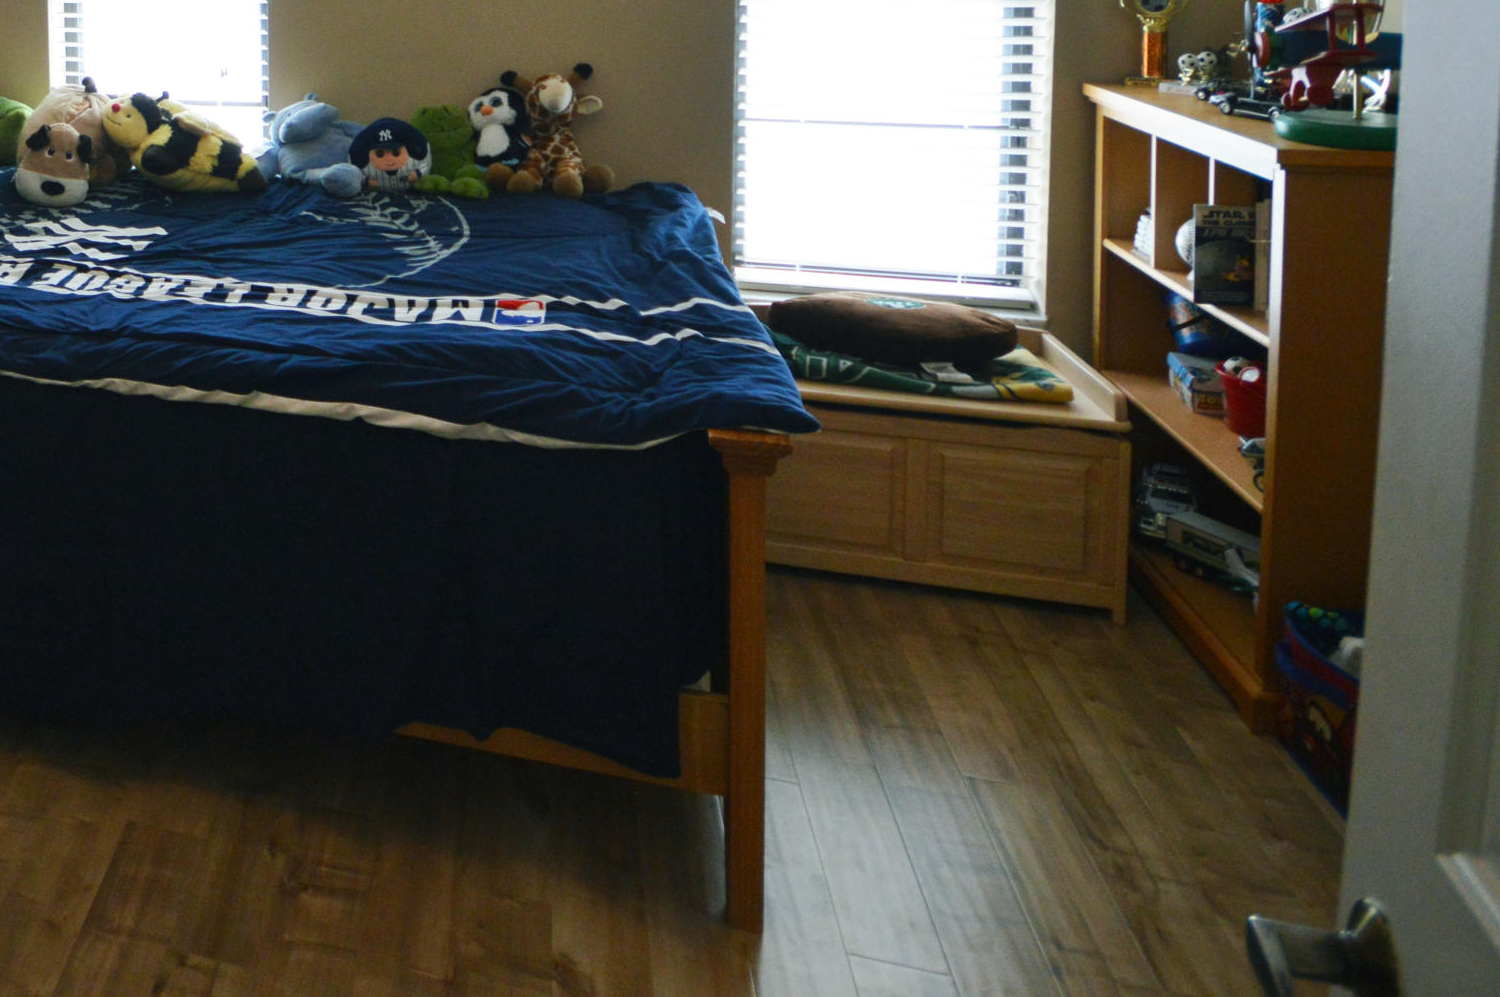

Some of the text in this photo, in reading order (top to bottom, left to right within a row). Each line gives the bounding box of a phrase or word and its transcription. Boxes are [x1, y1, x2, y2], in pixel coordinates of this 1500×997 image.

[379, 129, 392, 141] NY
[31, 264, 251, 303] LEAGUE
[264, 287, 485, 323] MAJOR
